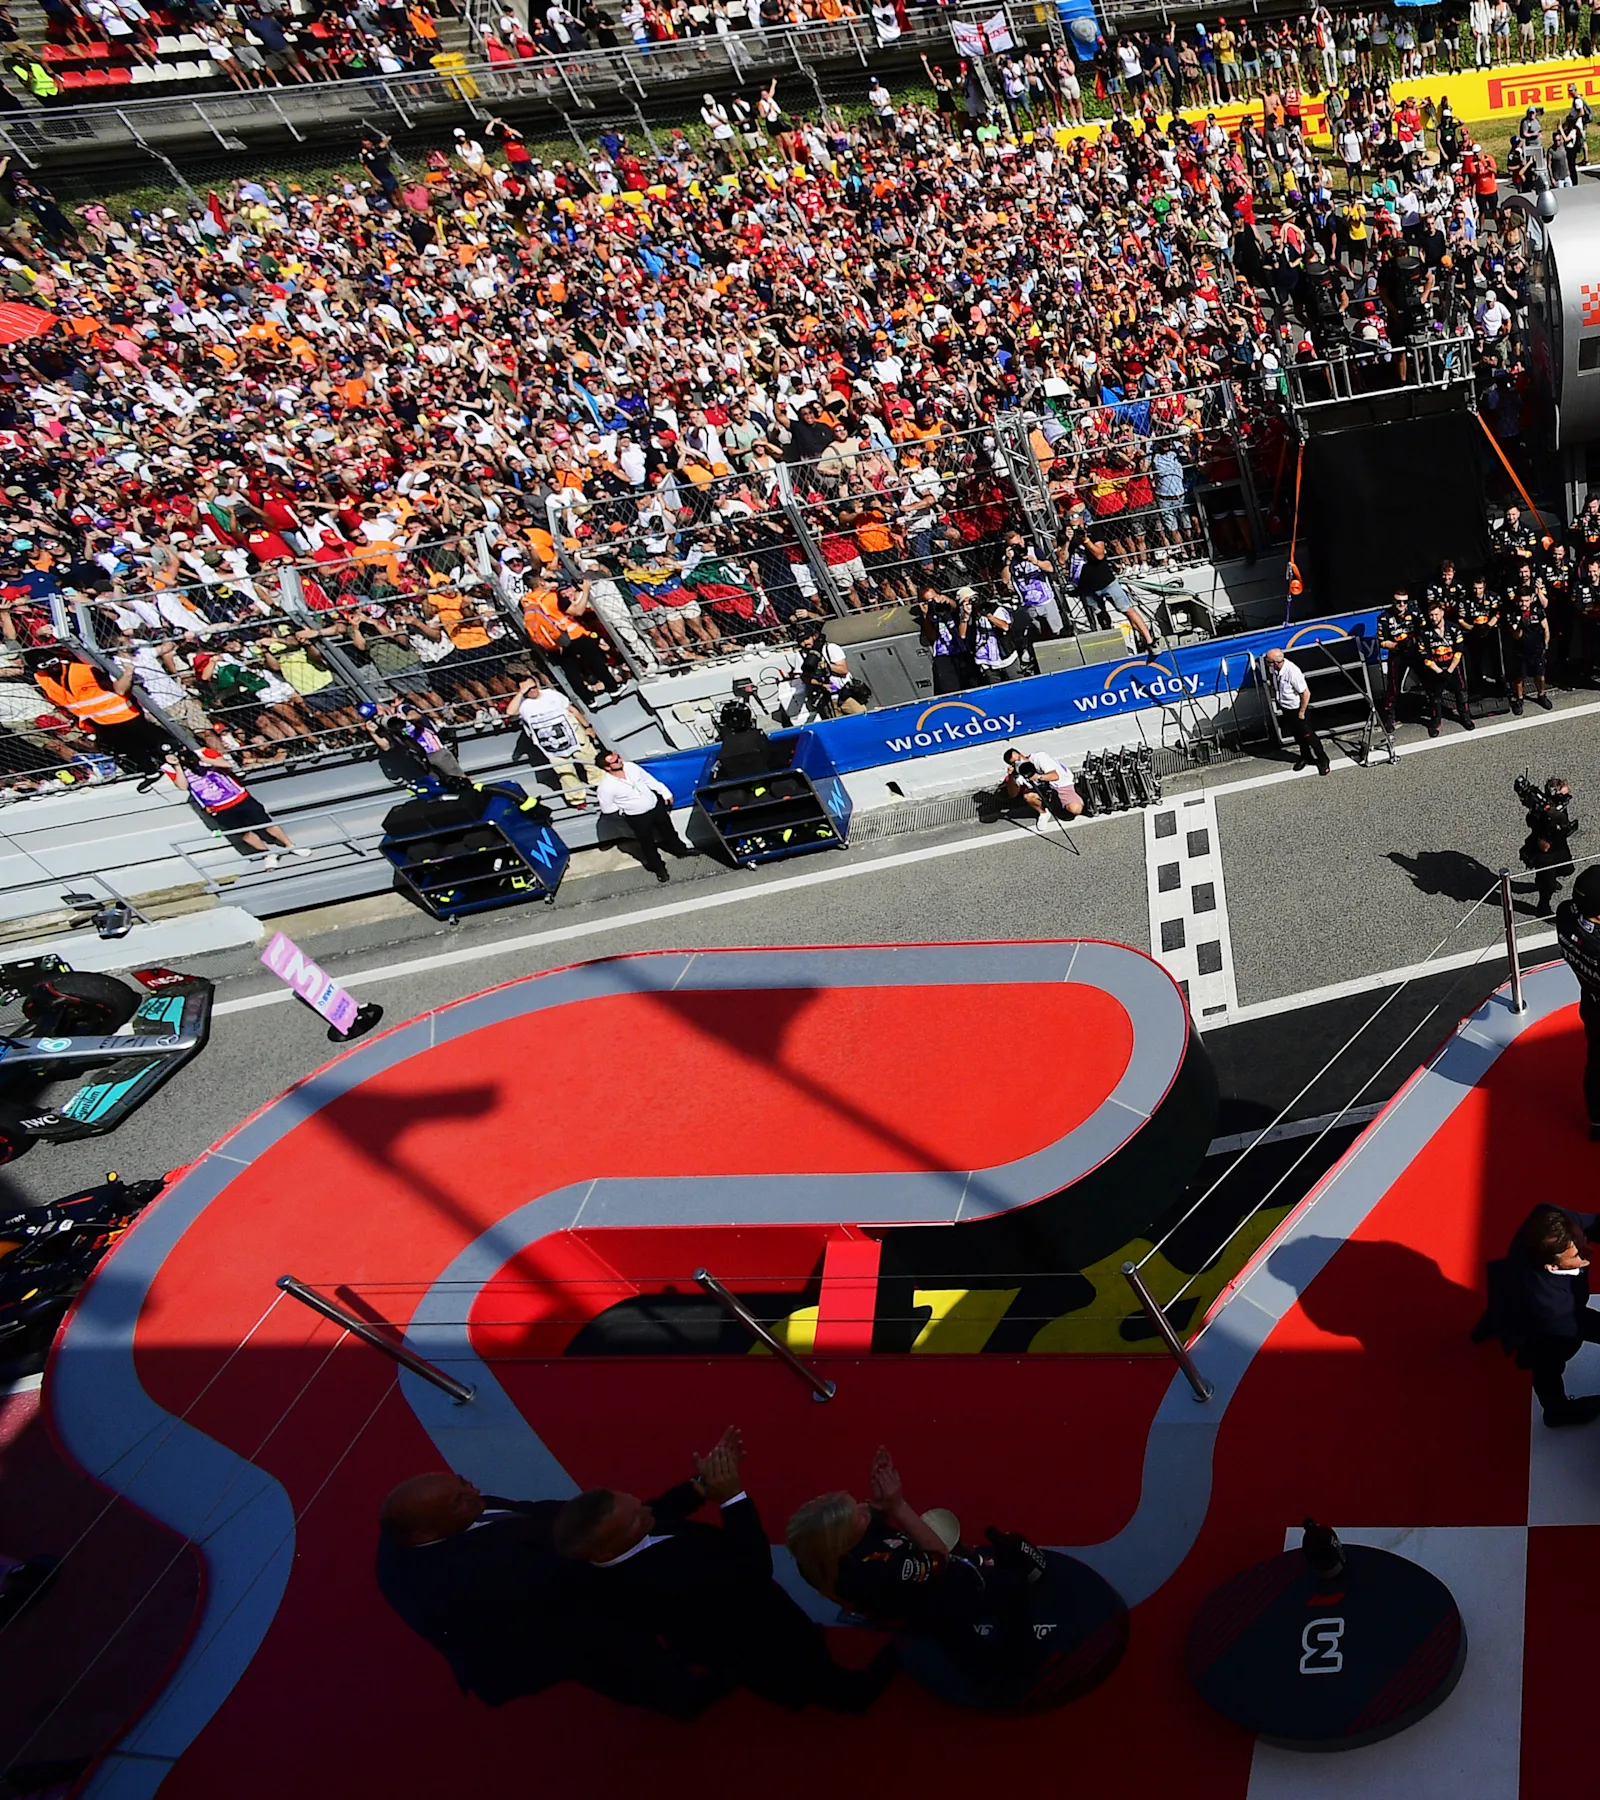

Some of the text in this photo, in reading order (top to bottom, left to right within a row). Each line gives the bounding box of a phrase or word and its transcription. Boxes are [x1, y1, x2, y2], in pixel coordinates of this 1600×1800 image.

[147, 974, 185, 988] INEOS
[322, 983, 335, 1002] BWT
[19, 1114, 60, 1130] IWC
